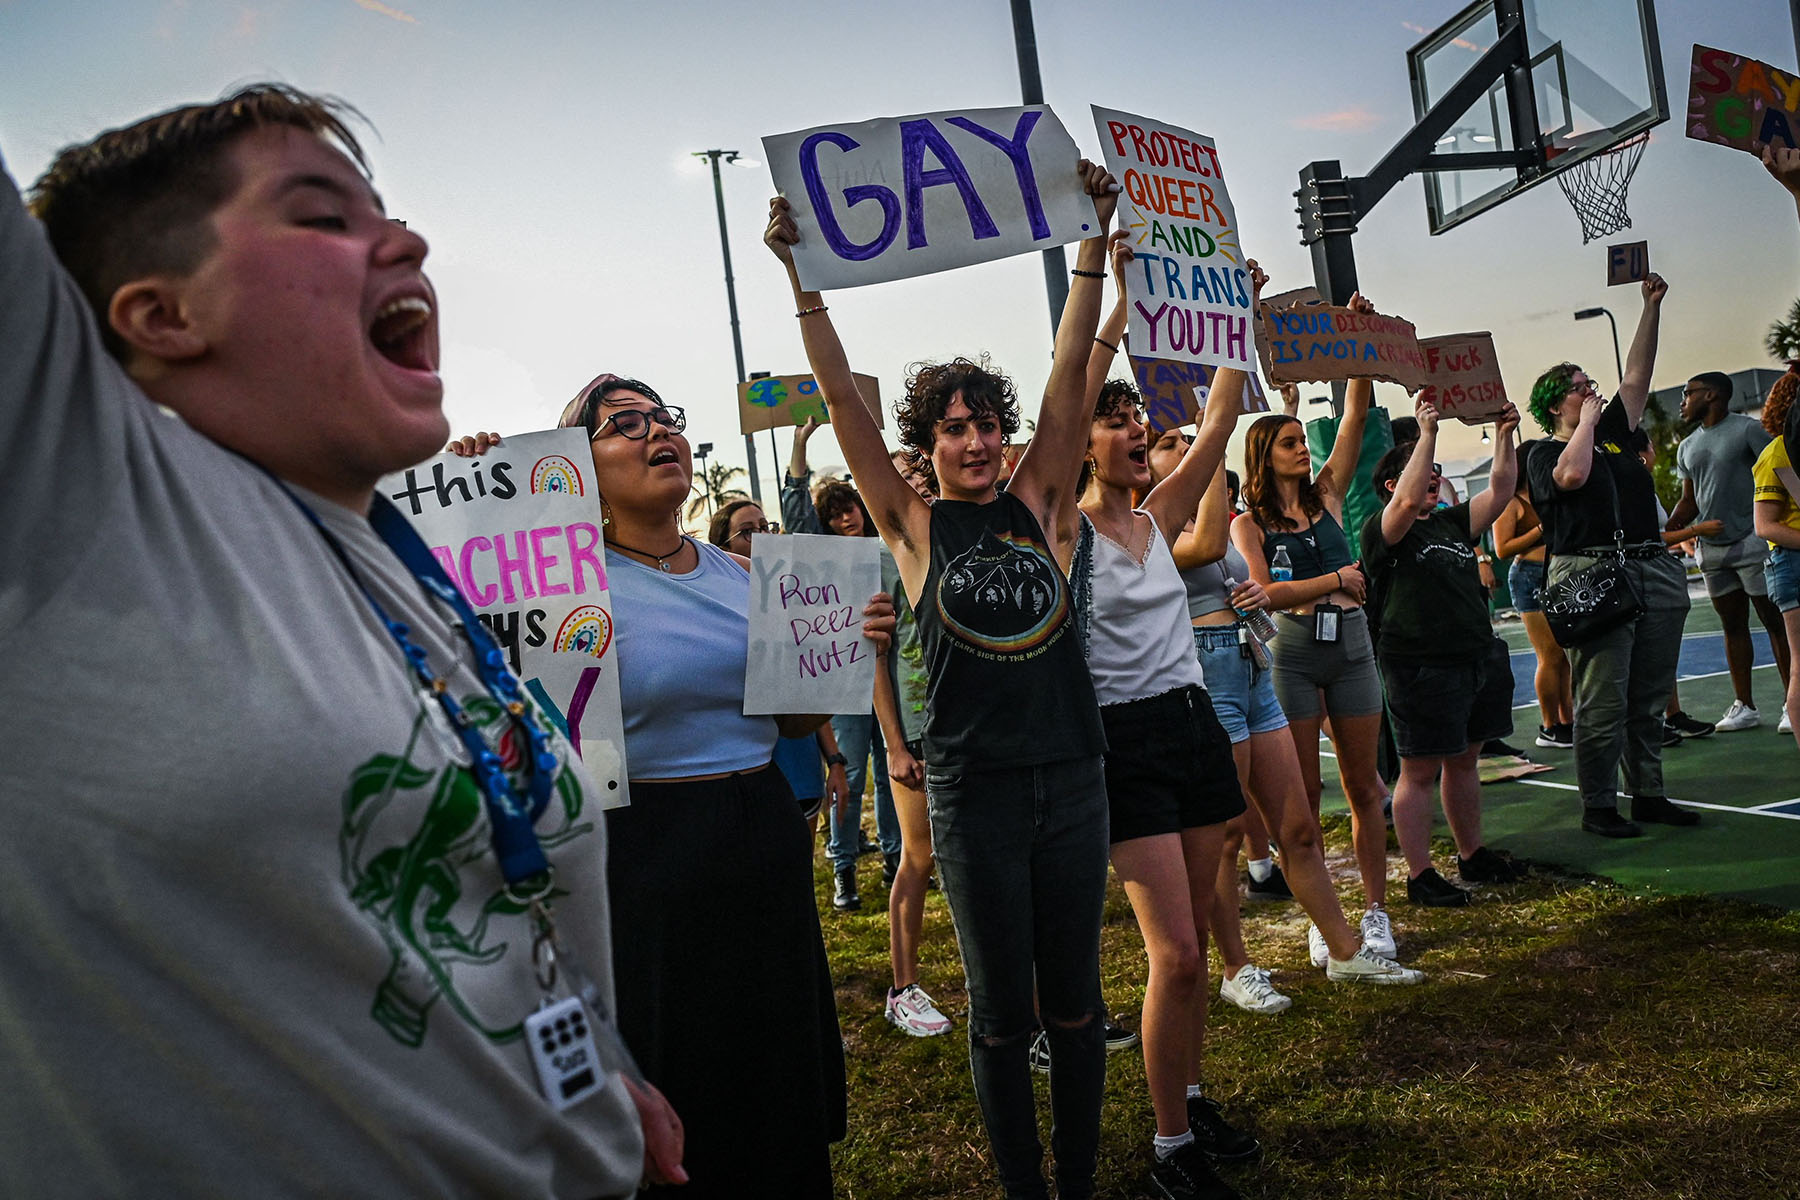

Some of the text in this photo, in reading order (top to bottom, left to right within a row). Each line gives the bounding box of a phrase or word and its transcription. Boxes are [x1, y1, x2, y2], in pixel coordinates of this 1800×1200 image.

[1696, 50, 1800, 113] SAY
[1715, 97, 1800, 149] GA
[1107, 121, 1222, 179] PROTECT
[1124, 168, 1228, 227] QUEER
[1151, 219, 1216, 258] AND
[1134, 252, 1250, 309] TRANS
[1611, 247, 1643, 279] FU
[1134, 301, 1248, 363] YOUTH
[1270, 313, 1335, 335] YOUR
[1272, 341, 1304, 364] IS
[1308, 339, 1357, 360] NOT
[1363, 342, 1379, 361] A
[1426, 345, 1482, 374] FUCK
[1423, 380, 1504, 411] FASCISM
[392, 461, 518, 515] this
[779, 574, 840, 610] Ron
[941, 629, 954, 643] THE
[954, 640, 975, 654] DARK
[976, 650, 995, 661] SIDE
[996, 654, 1007, 662] OF
[1008, 653, 1025, 662] THE
[1026, 645, 1048, 660] MOON
